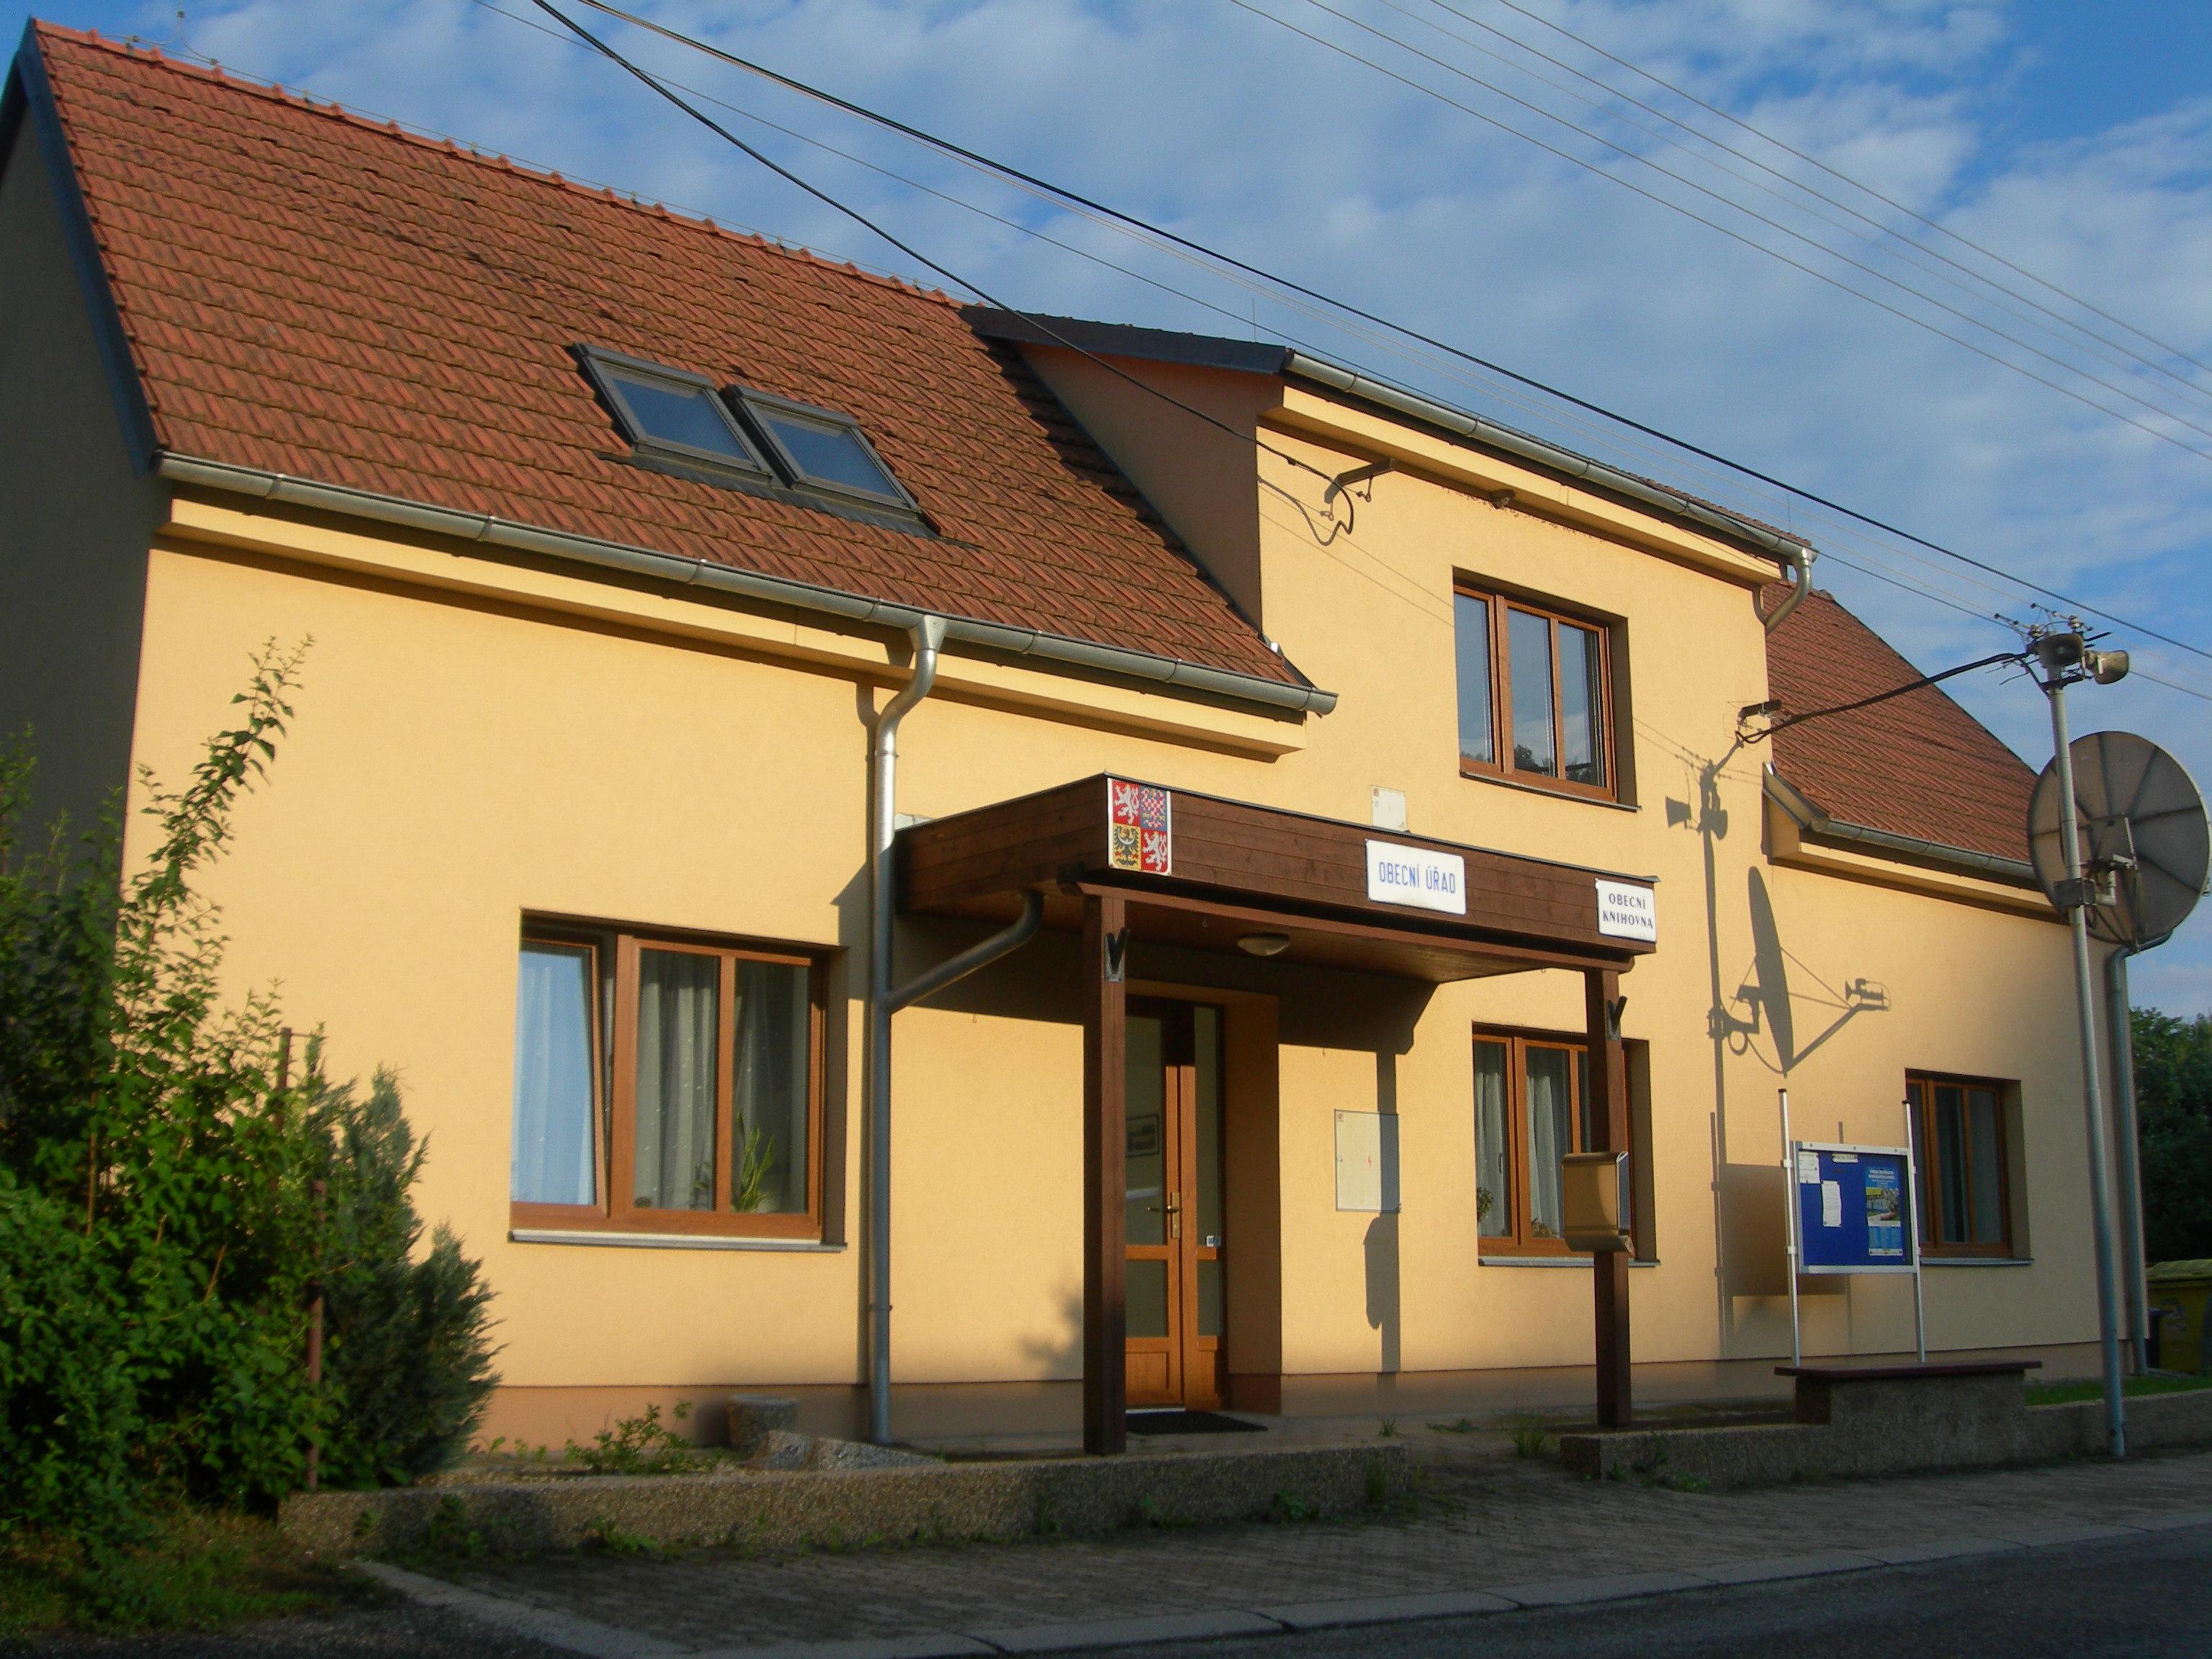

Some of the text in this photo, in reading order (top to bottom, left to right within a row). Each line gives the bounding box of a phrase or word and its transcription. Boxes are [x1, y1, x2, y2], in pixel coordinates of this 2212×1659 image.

[1378, 861, 1456, 894] OBECNÍ ÚŘAD
[1608, 893, 1645, 909] OBECNÍ
[1602, 910, 1653, 929] KNIHOVNA
